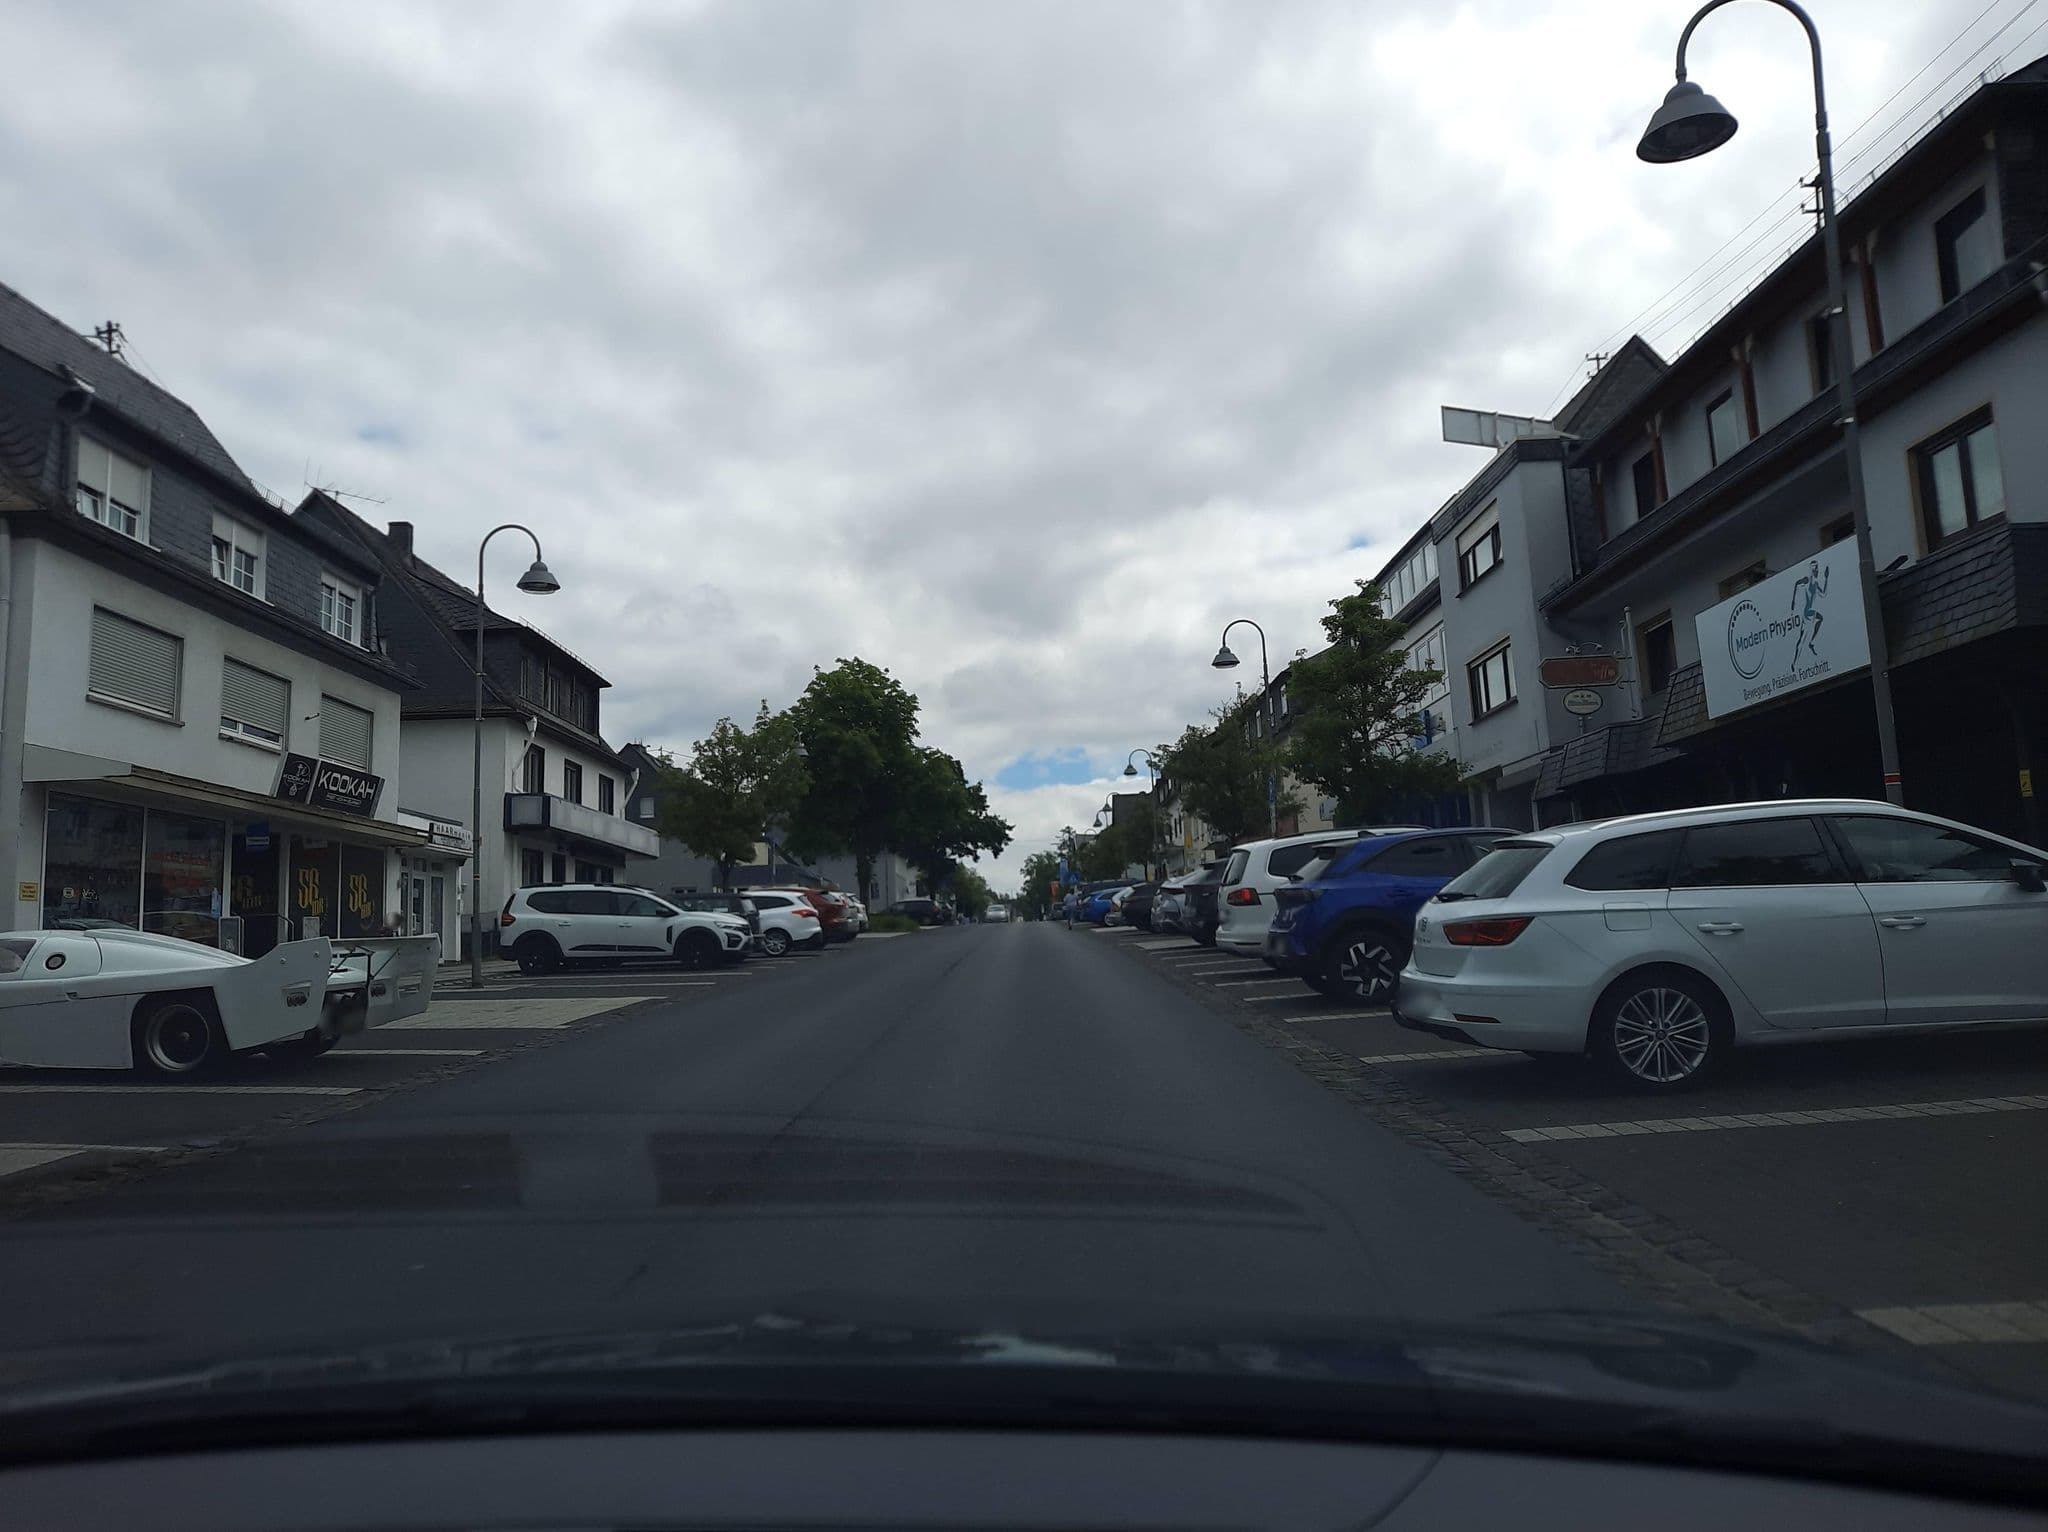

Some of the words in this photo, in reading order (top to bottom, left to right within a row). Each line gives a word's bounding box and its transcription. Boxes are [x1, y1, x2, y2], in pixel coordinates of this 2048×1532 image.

[1735, 629, 1769, 653] Modern
[1769, 614, 1801, 639] Physio
[317, 768, 376, 801] KOOKAH
